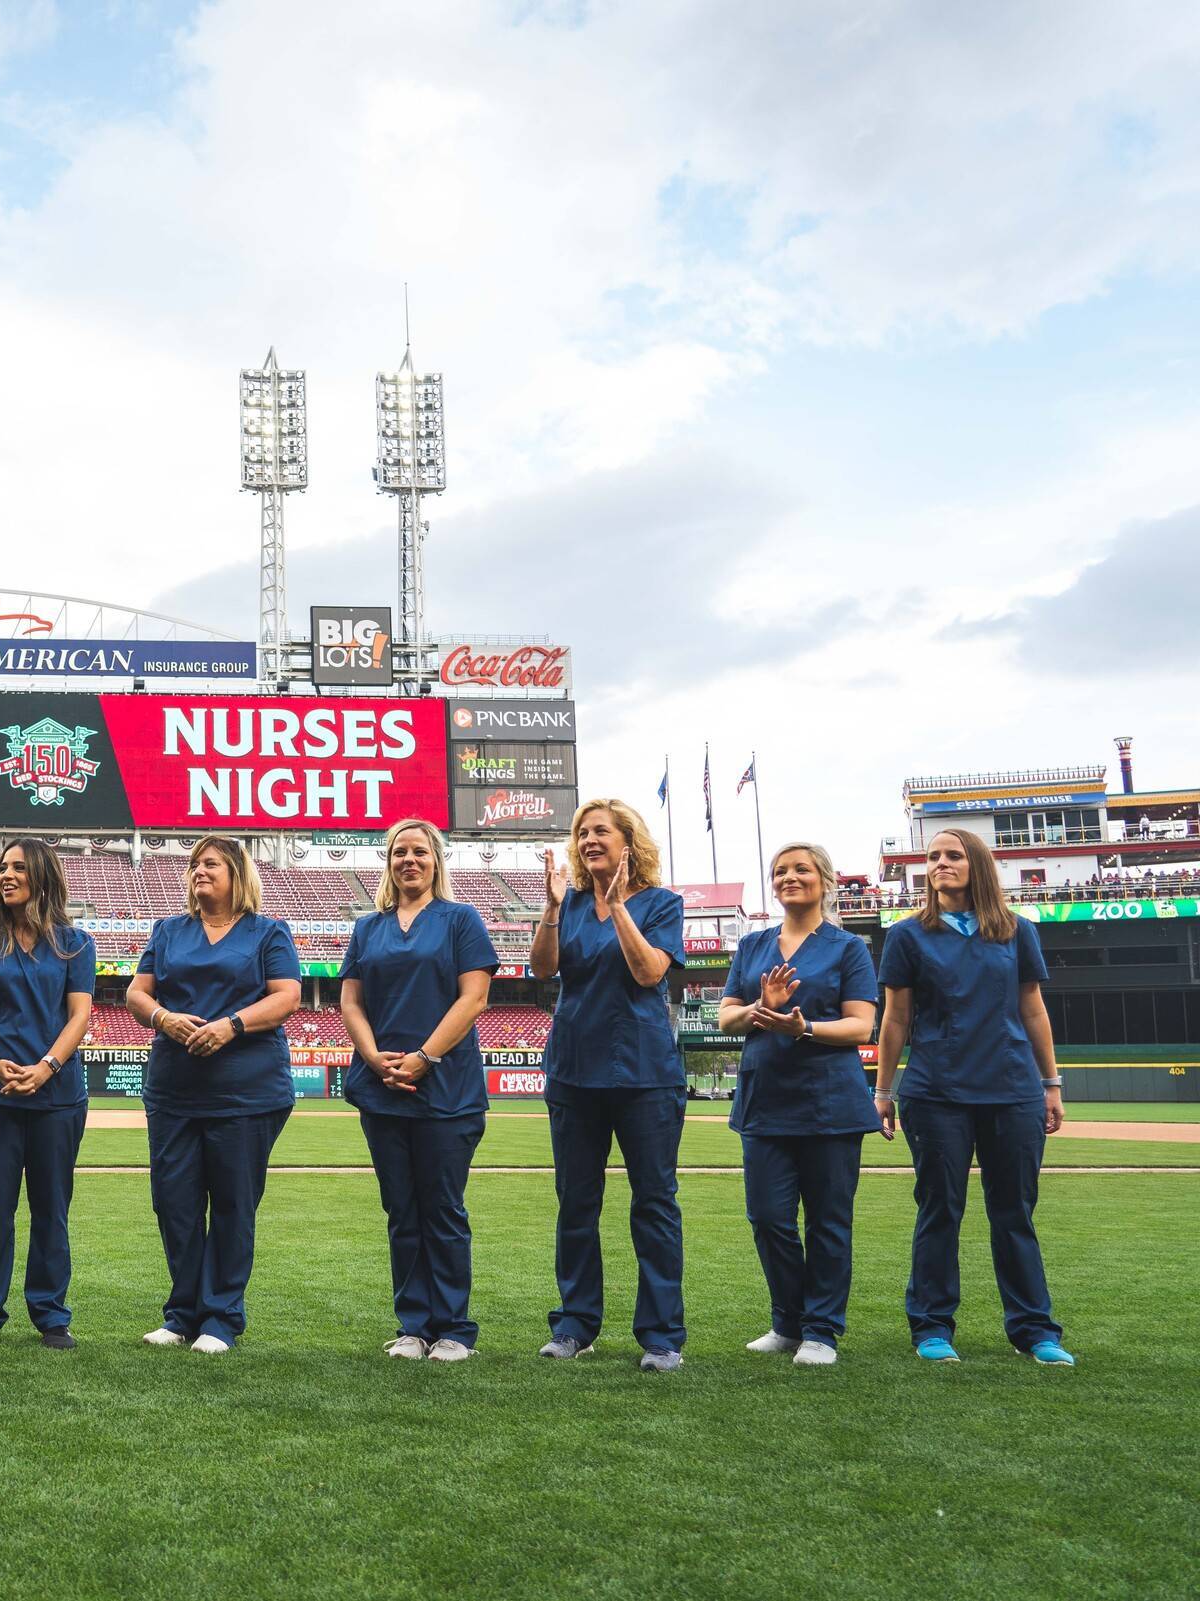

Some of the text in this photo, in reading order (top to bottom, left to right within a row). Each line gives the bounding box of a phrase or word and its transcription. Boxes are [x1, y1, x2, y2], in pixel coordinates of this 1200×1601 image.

[318, 618, 382, 646] BIG
[143, 661, 210, 674] INSURANCE
[211, 662, 249, 674] GROUP
[440, 645, 569, 687] Coca-Cola
[162, 707, 416, 760] NURSES
[3, 760, 20, 770] EST.
[23, 744, 71, 777] 150
[461, 757, 517, 770] DRAFT
[16, 773, 32, 783] RED
[468, 769, 516, 779] KINGS
[38, 775, 83, 789] STOCKINGS
[188, 767, 394, 819] NIGHT
[504, 789, 534, 804] John
[995, 797, 1030, 807] PILOT
[1032, 795, 1073, 804] HOUSE
[477, 797, 555, 826] Morrell
[314, 836, 370, 846] ULTIMATE
[1091, 901, 1143, 921] ZOO
[691, 940, 716, 950] PATIO
[84, 1050, 149, 1062] BATTERIES
[491, 1053, 524, 1065] DEAD
[1169, 1066, 1186, 1076] 404
